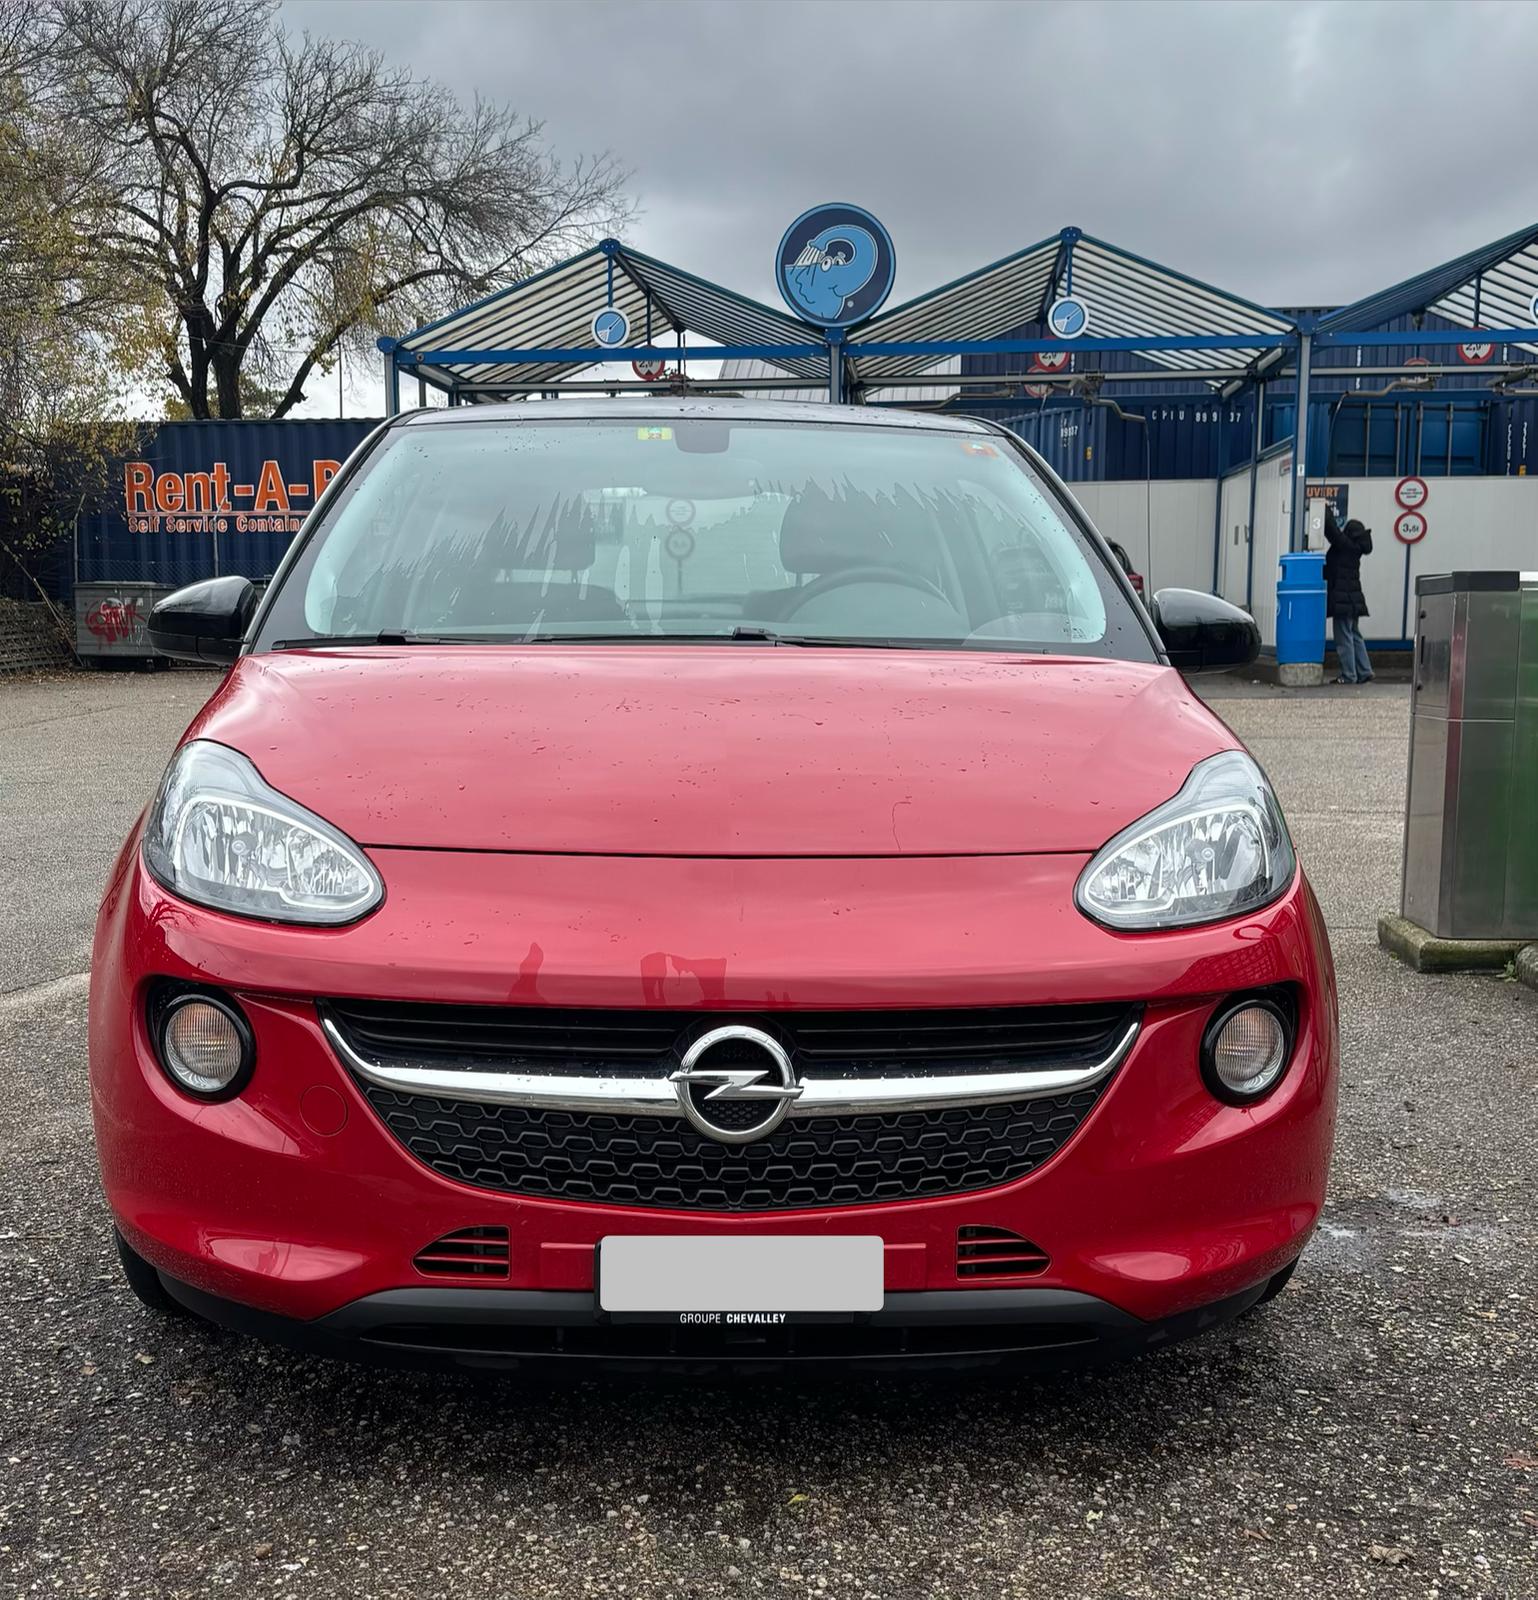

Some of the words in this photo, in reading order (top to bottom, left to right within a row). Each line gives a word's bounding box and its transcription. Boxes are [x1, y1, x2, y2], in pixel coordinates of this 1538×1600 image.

[128, 516, 160, 533] Self
[166, 516, 228, 533] Service
[1312, 518, 1322, 530] 3
[680, 1313, 720, 1324] GROUPE
[726, 1313, 786, 1324] CHEVALLEY
